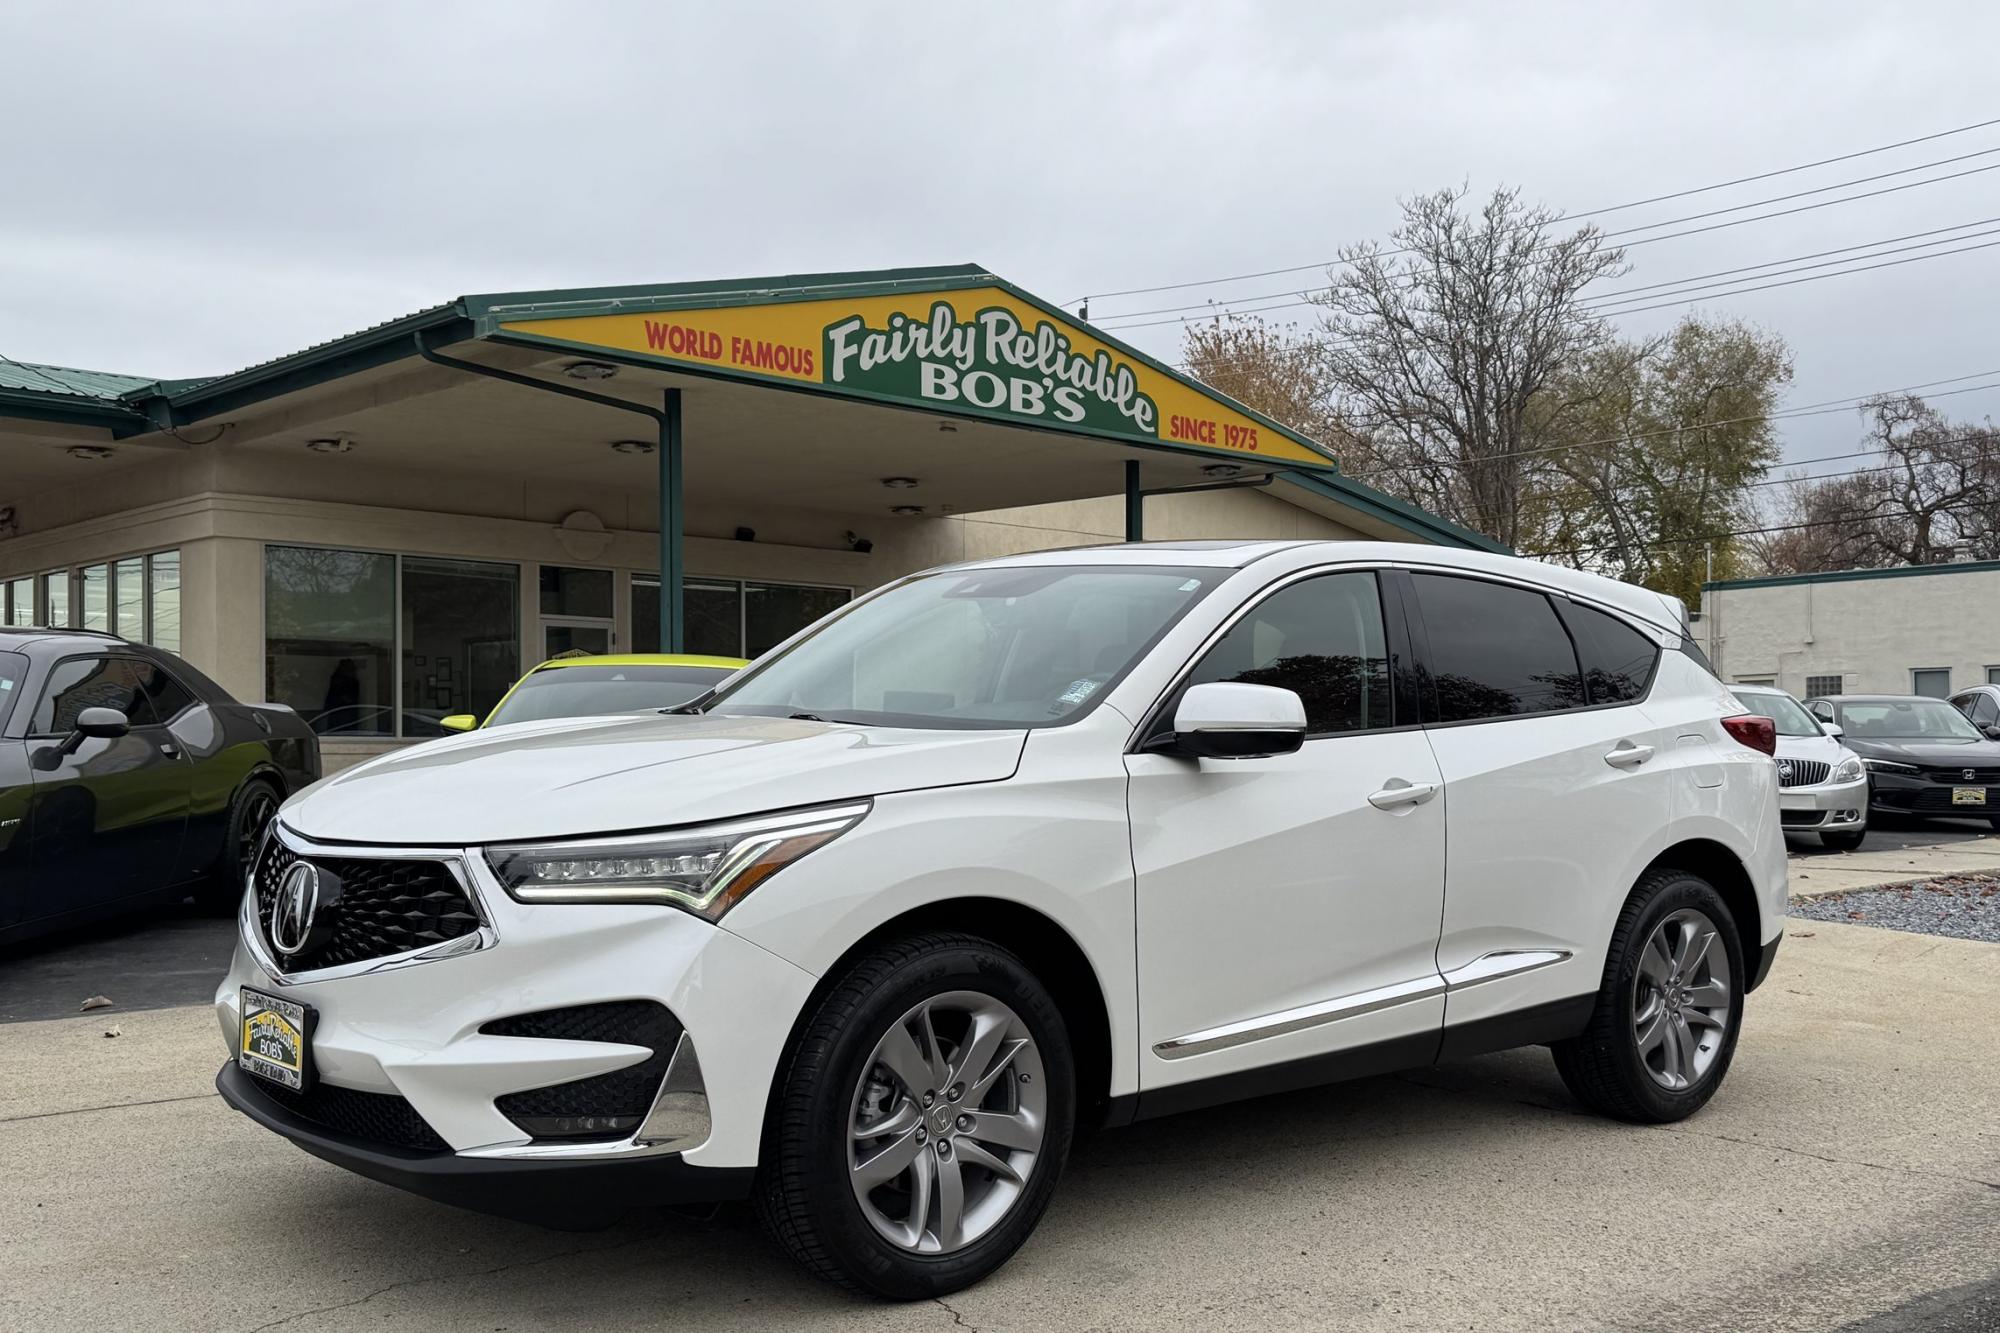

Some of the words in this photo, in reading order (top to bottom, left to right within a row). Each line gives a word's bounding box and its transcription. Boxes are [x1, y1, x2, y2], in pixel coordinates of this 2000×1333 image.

[644, 319, 723, 360] WORLD
[731, 336, 814, 376] FAMOUS
[828, 305, 976, 382] Fairly
[979, 310, 1156, 433] Reliable
[921, 361, 1086, 423] BOB'S
[1170, 414, 1216, 444] SINCE
[1223, 424, 1258, 451] 1975
